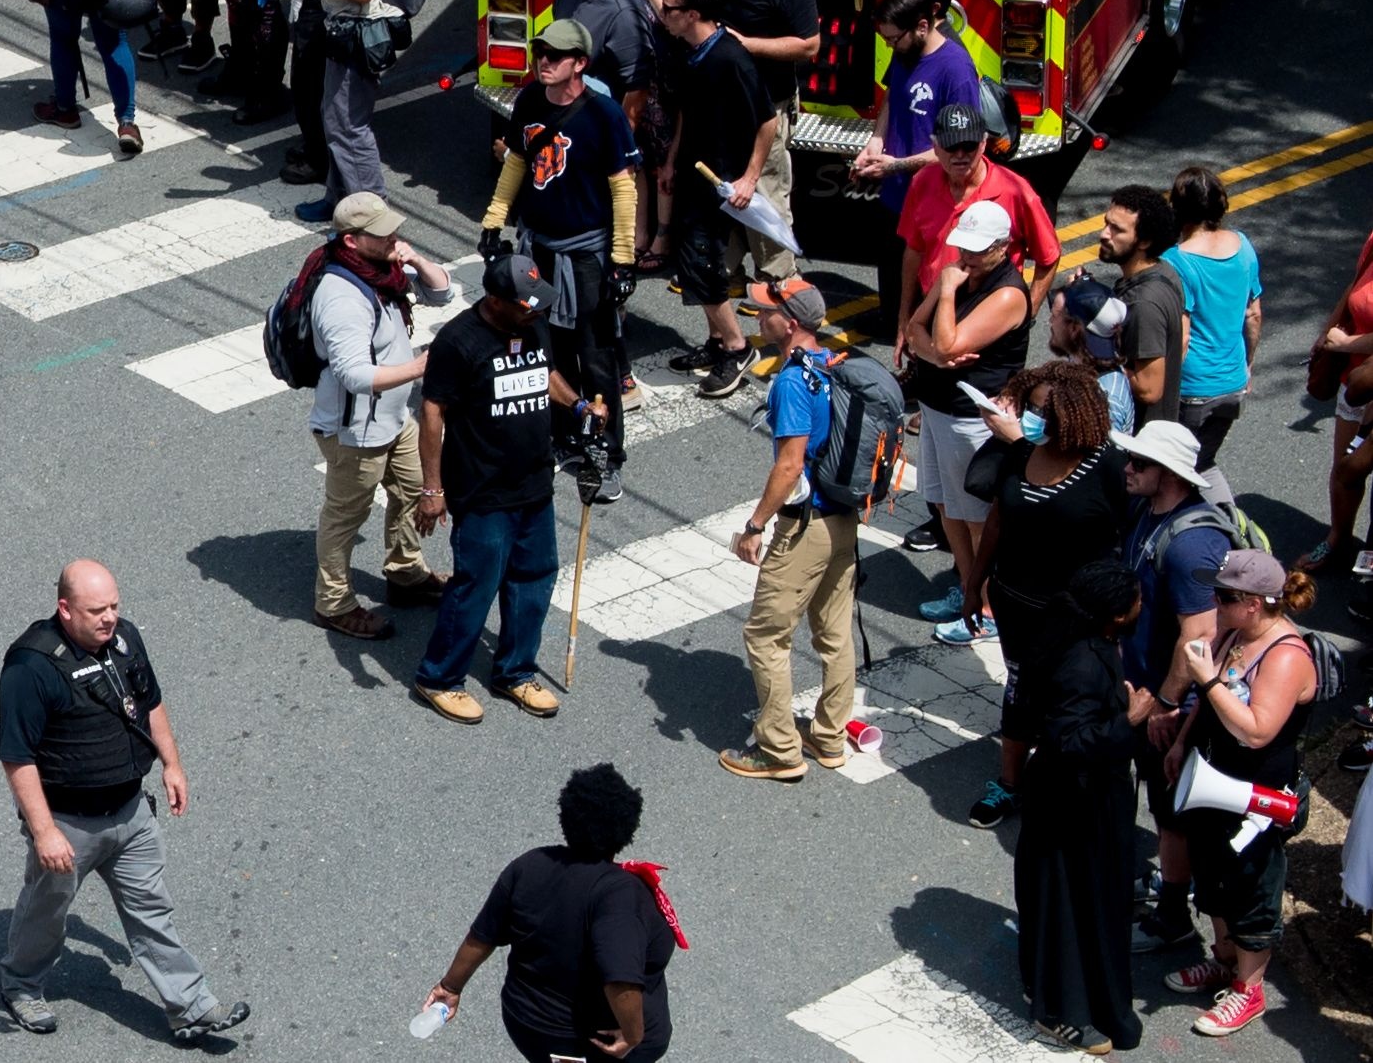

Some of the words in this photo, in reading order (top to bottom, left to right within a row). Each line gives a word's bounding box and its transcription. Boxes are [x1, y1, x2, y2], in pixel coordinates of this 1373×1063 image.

[492, 348, 547, 372] BLACK
[501, 372, 546, 393] LIVES
[71, 663, 103, 679] POLICE
